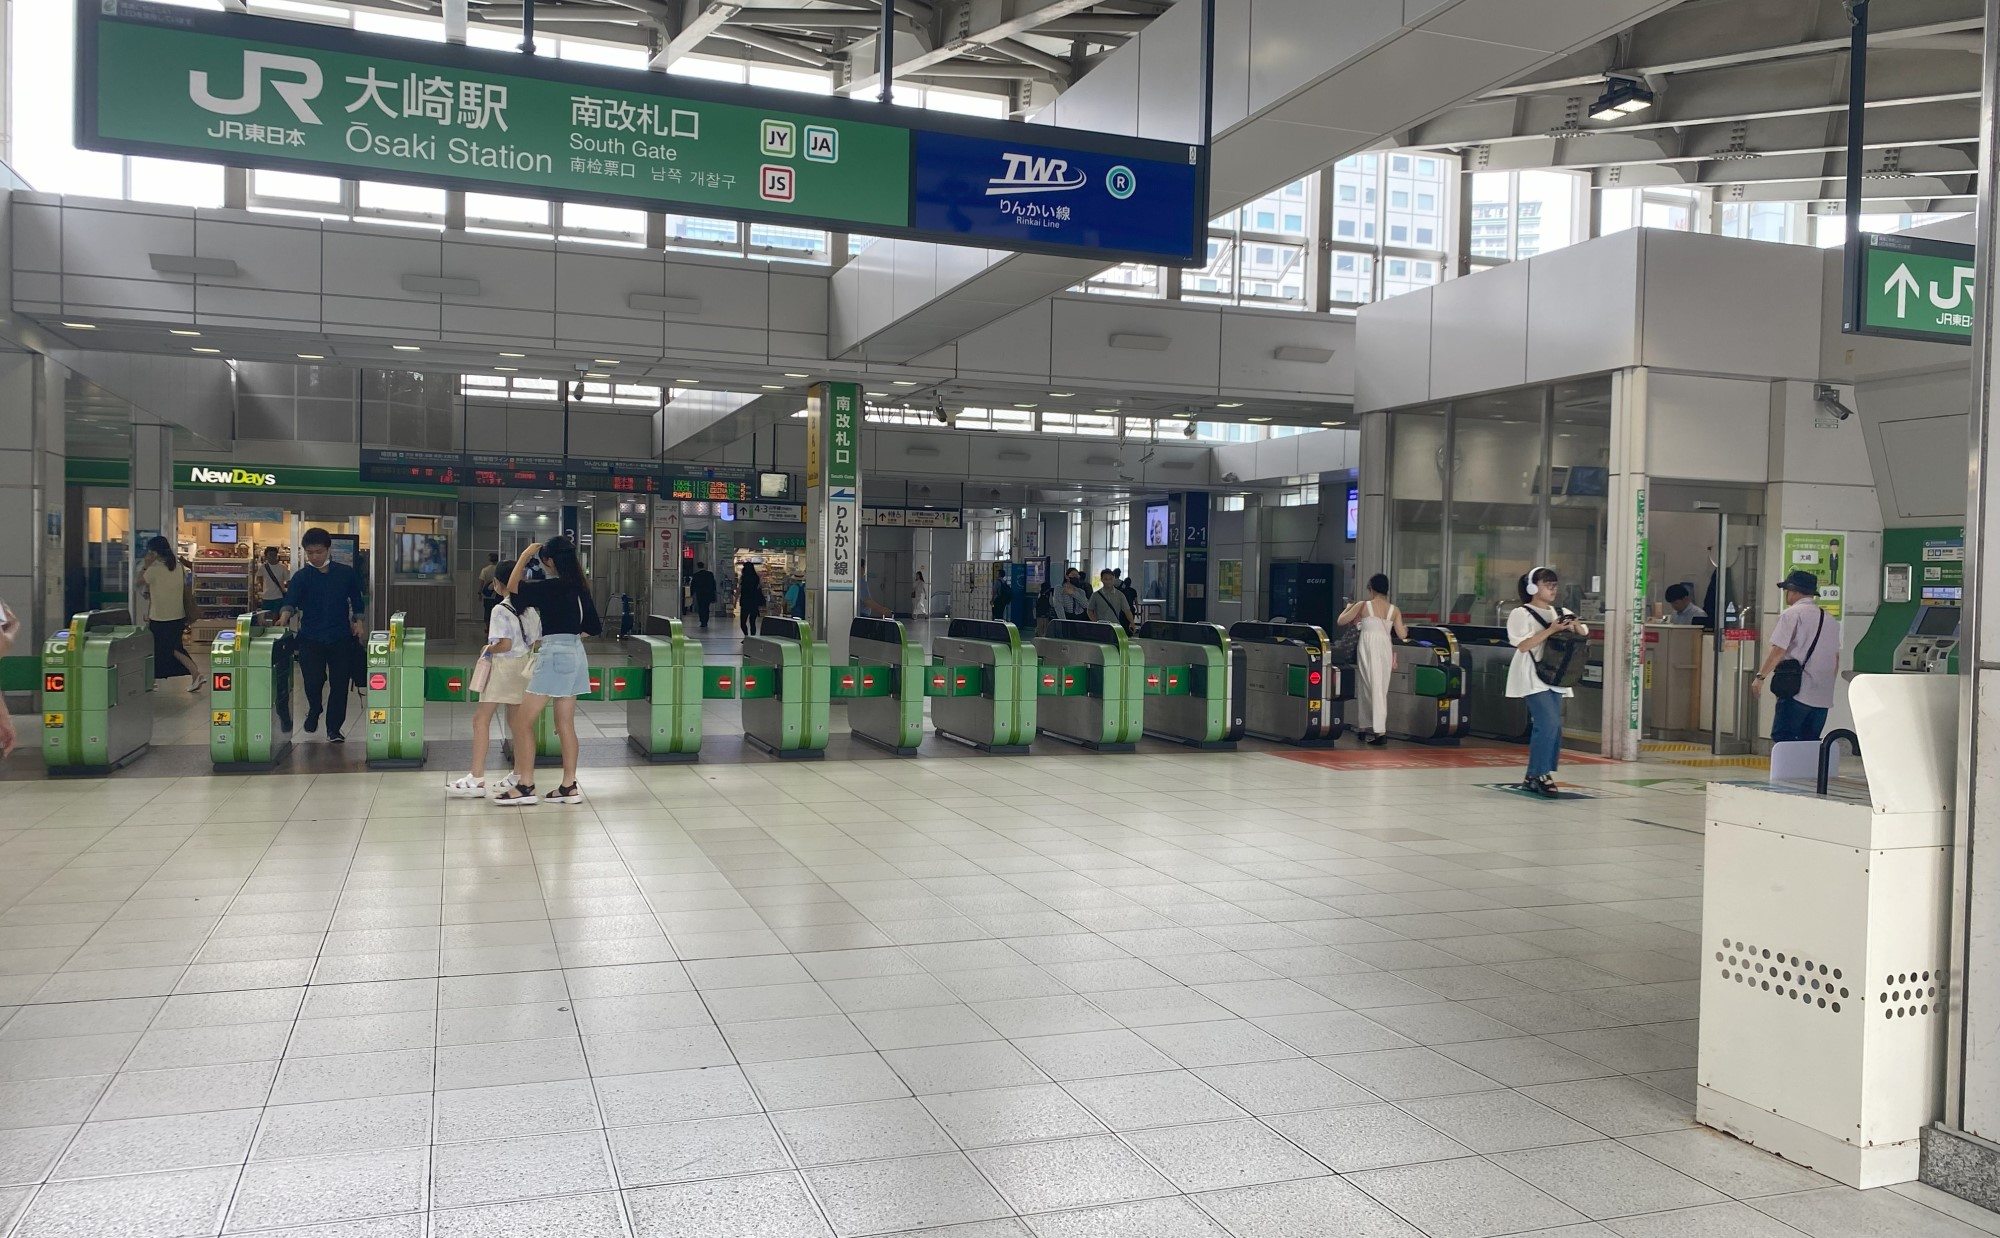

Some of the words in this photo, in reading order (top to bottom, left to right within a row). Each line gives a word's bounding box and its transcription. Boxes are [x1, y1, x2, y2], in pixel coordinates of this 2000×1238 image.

[189, 49, 324, 125] JR
[344, 66, 509, 133] 大崎駅
[570, 95, 700, 140] 南改札口
[207, 120, 306, 147] JR東日本
[768, 131, 788, 146] JY
[811, 136, 832, 153] JA
[447, 137, 552, 174] Station
[569, 132, 625, 155] South
[632, 140, 678, 162] Gate
[569, 156, 636, 179] 南检票口
[651, 165, 683, 184] 남쪽
[690, 170, 738, 190] 개찰구
[1001, 152, 1068, 183] TWR
[768, 176, 787, 191] JS
[1000, 198, 1071, 221] りんかい線
[1016, 216, 1041, 228] Rinkai
[1043, 219, 1060, 229] Line
[1936, 312, 1973, 328] JR東日
[835, 396, 850, 465] 南改札口
[191, 467, 276, 486] NewDays
[834, 505, 849, 577] りんかい線
[45, 643, 67, 654] IC
[211, 642, 234, 654] IC
[369, 643, 388, 655] IC
[214, 656, 231, 665] 専用
[46, 676, 64, 690] IC
[215, 675, 231, 689] IC
